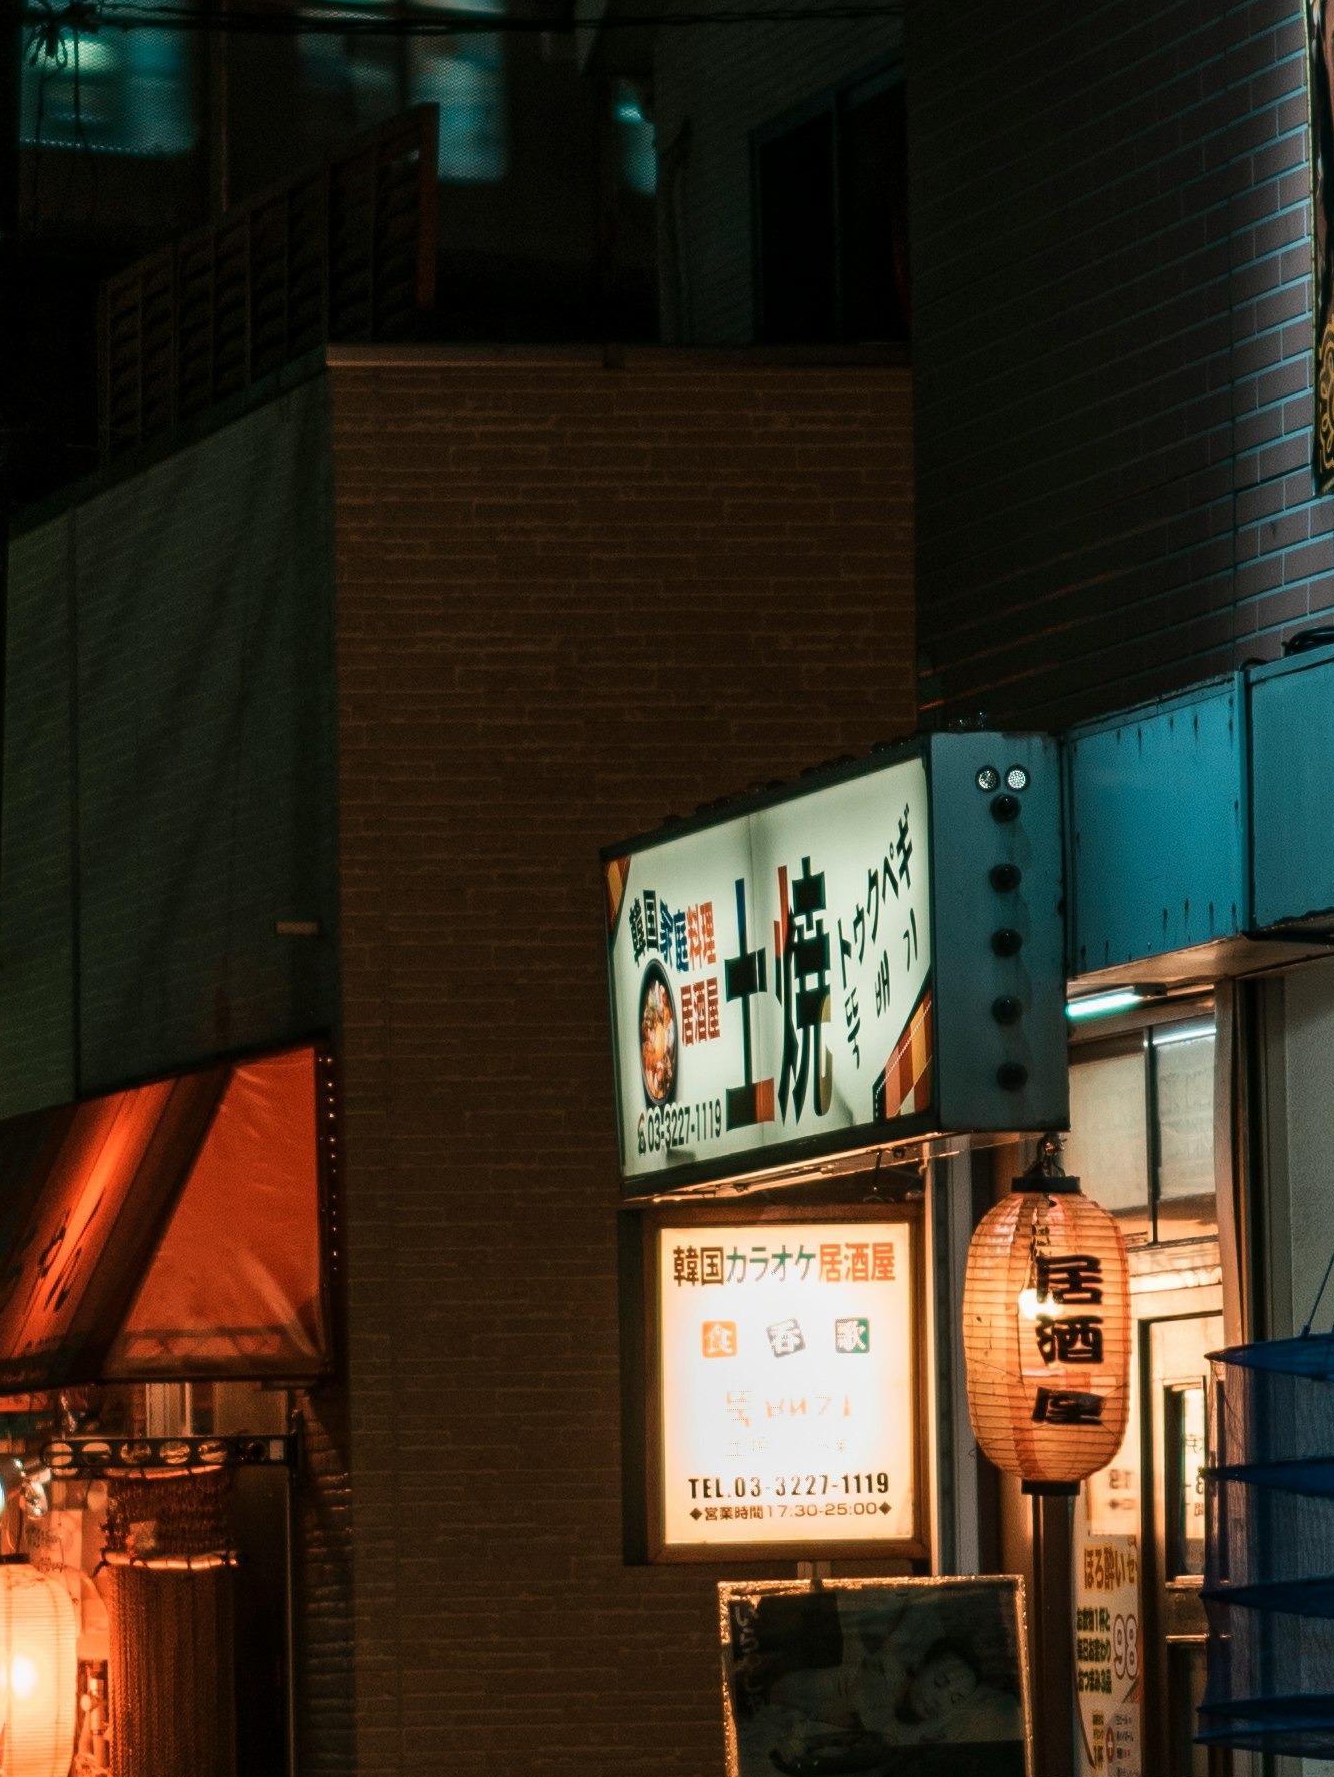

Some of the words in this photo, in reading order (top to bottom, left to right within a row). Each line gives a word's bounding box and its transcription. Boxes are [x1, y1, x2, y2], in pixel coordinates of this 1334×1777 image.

[629, 889, 718, 973] 韓国家庭料理
[680, 976, 721, 1048] 居酒屋
[672, 1241, 896, 1288] 韓国カラオケ居酒屋
[704, 1321, 735, 1356] 食
[835, 1318, 869, 1353] 歌
